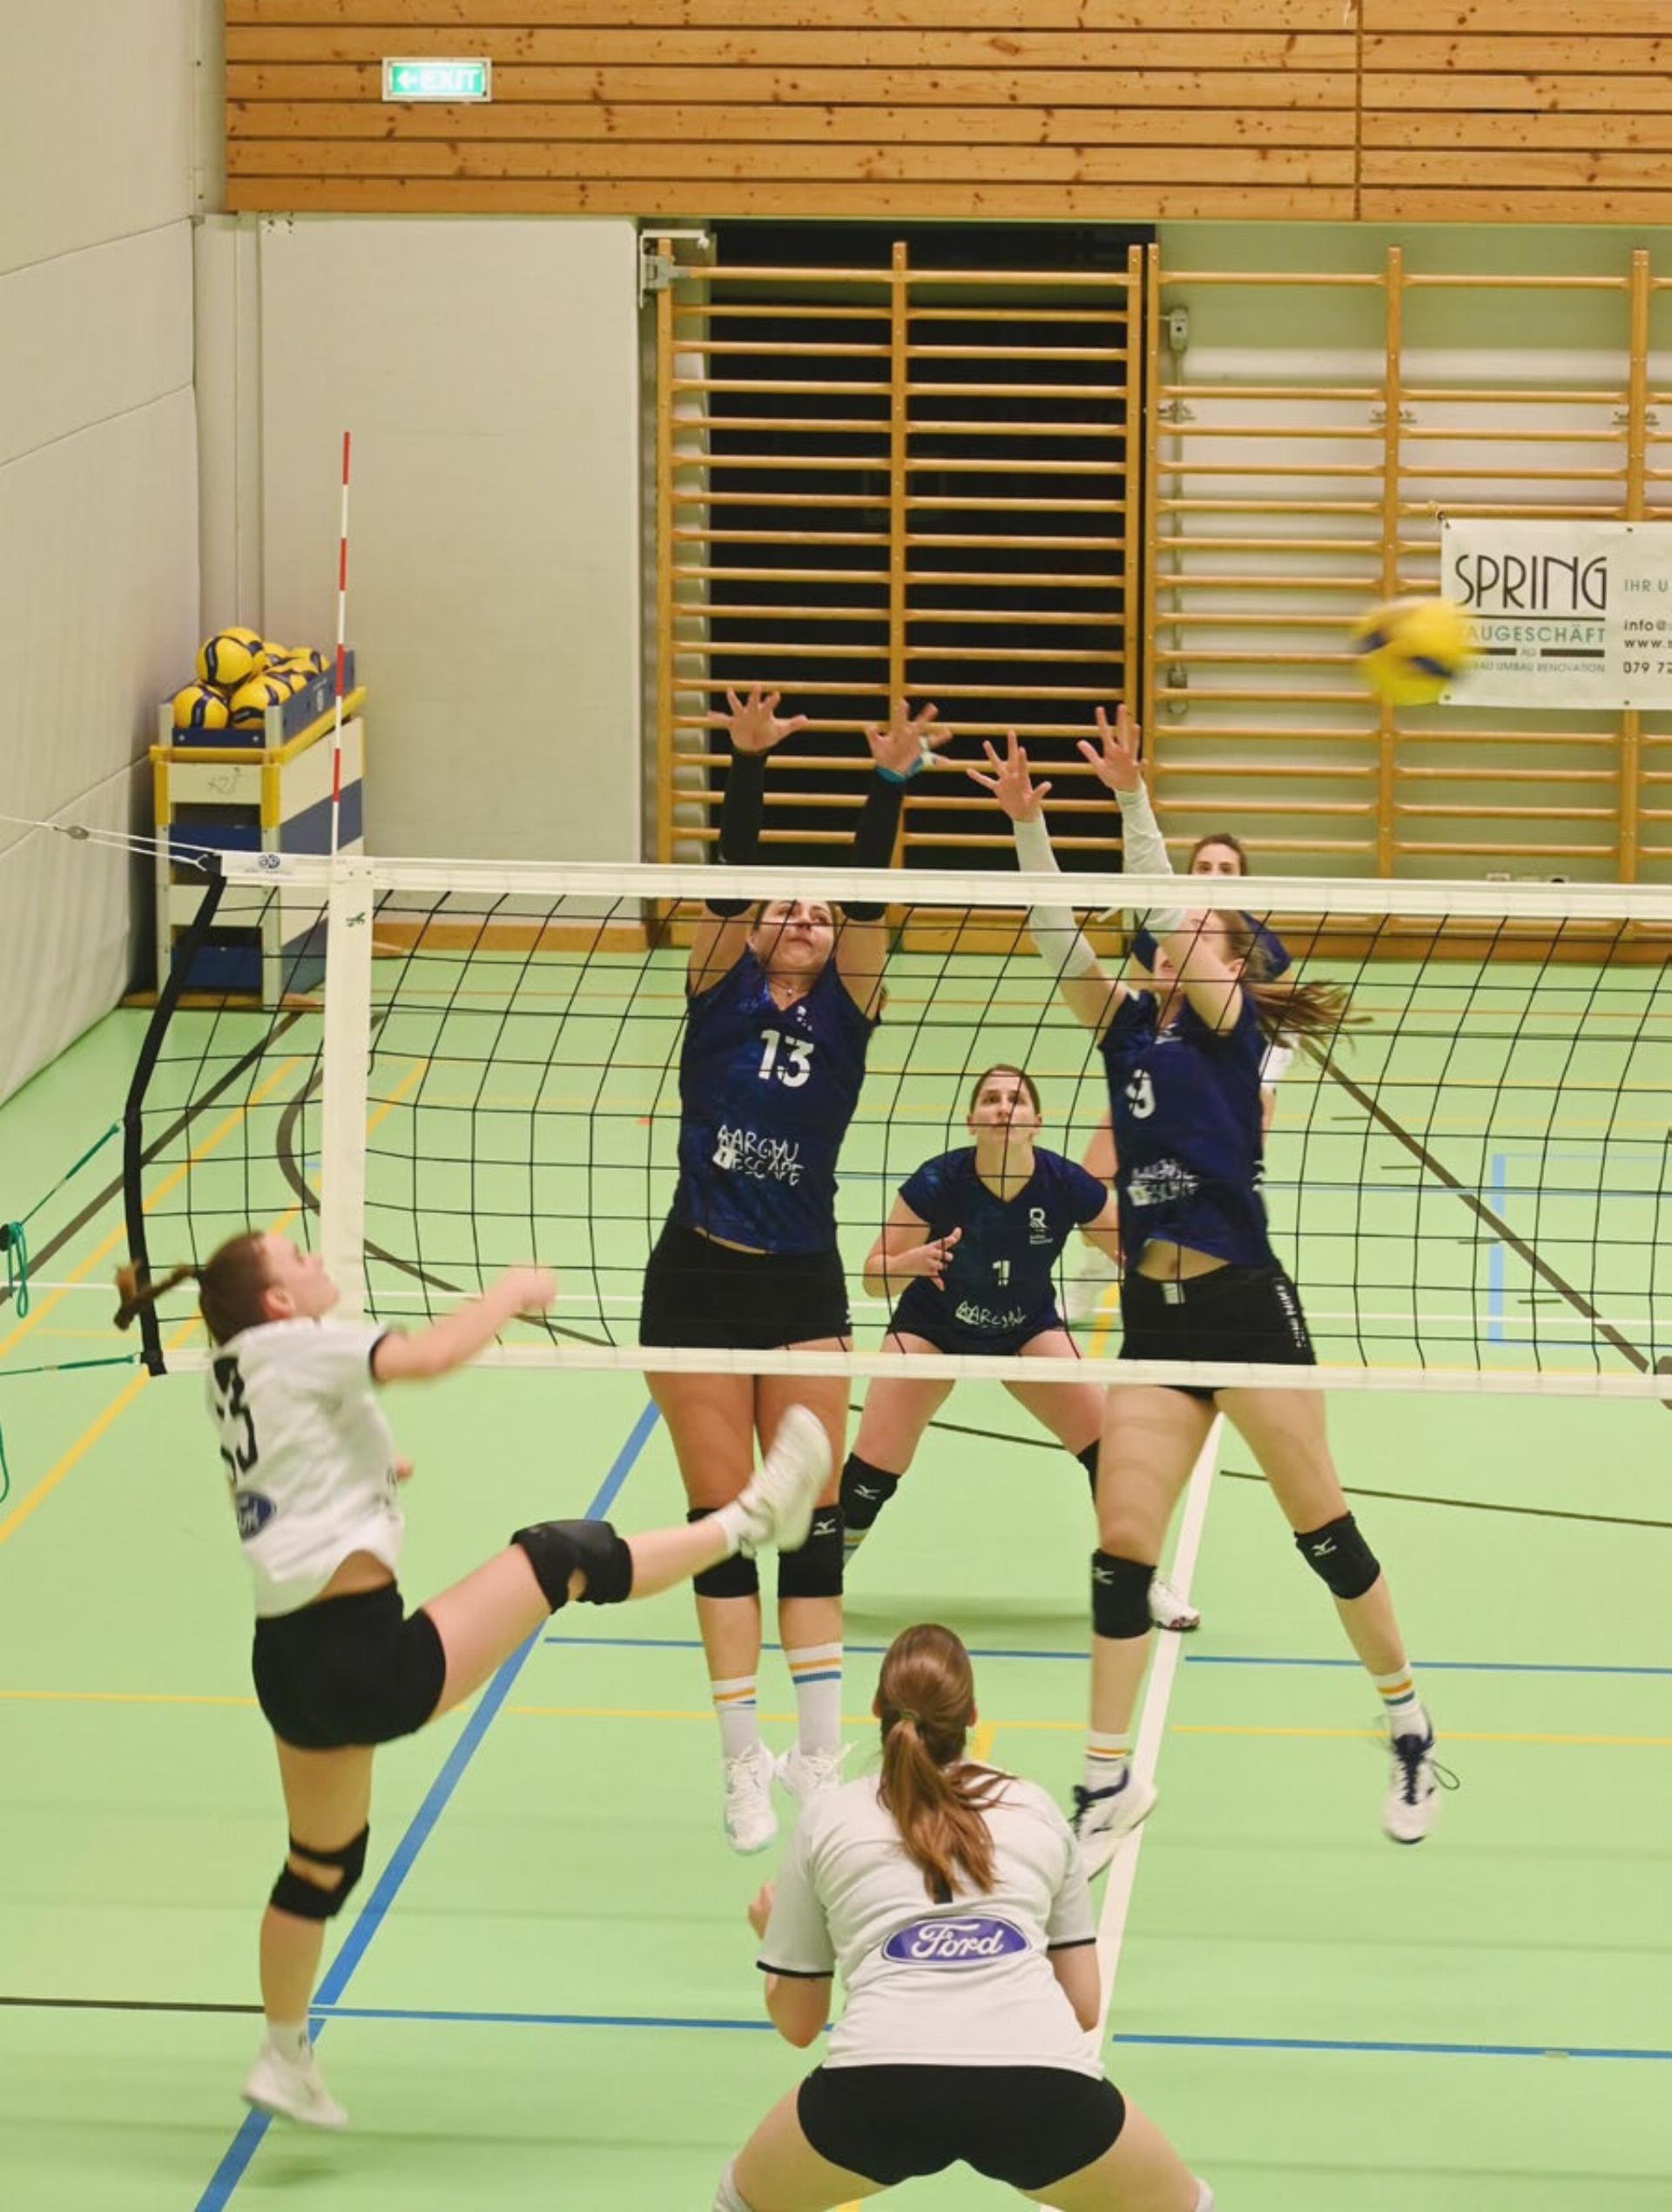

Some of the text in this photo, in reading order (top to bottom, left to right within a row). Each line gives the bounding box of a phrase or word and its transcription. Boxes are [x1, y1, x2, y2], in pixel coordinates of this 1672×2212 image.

[421, 69, 480, 91] EXIT
[1454, 555, 1607, 610] SPRING
[1624, 579, 1651, 592] IHR
[1465, 624, 1605, 643] AUGESCHÄFT
[1623, 662, 1650, 674] 079
[758, 1029, 815, 1088] 13
[992, 1260, 1011, 1286] 1
[911, 1923, 1004, 1959] Ford
